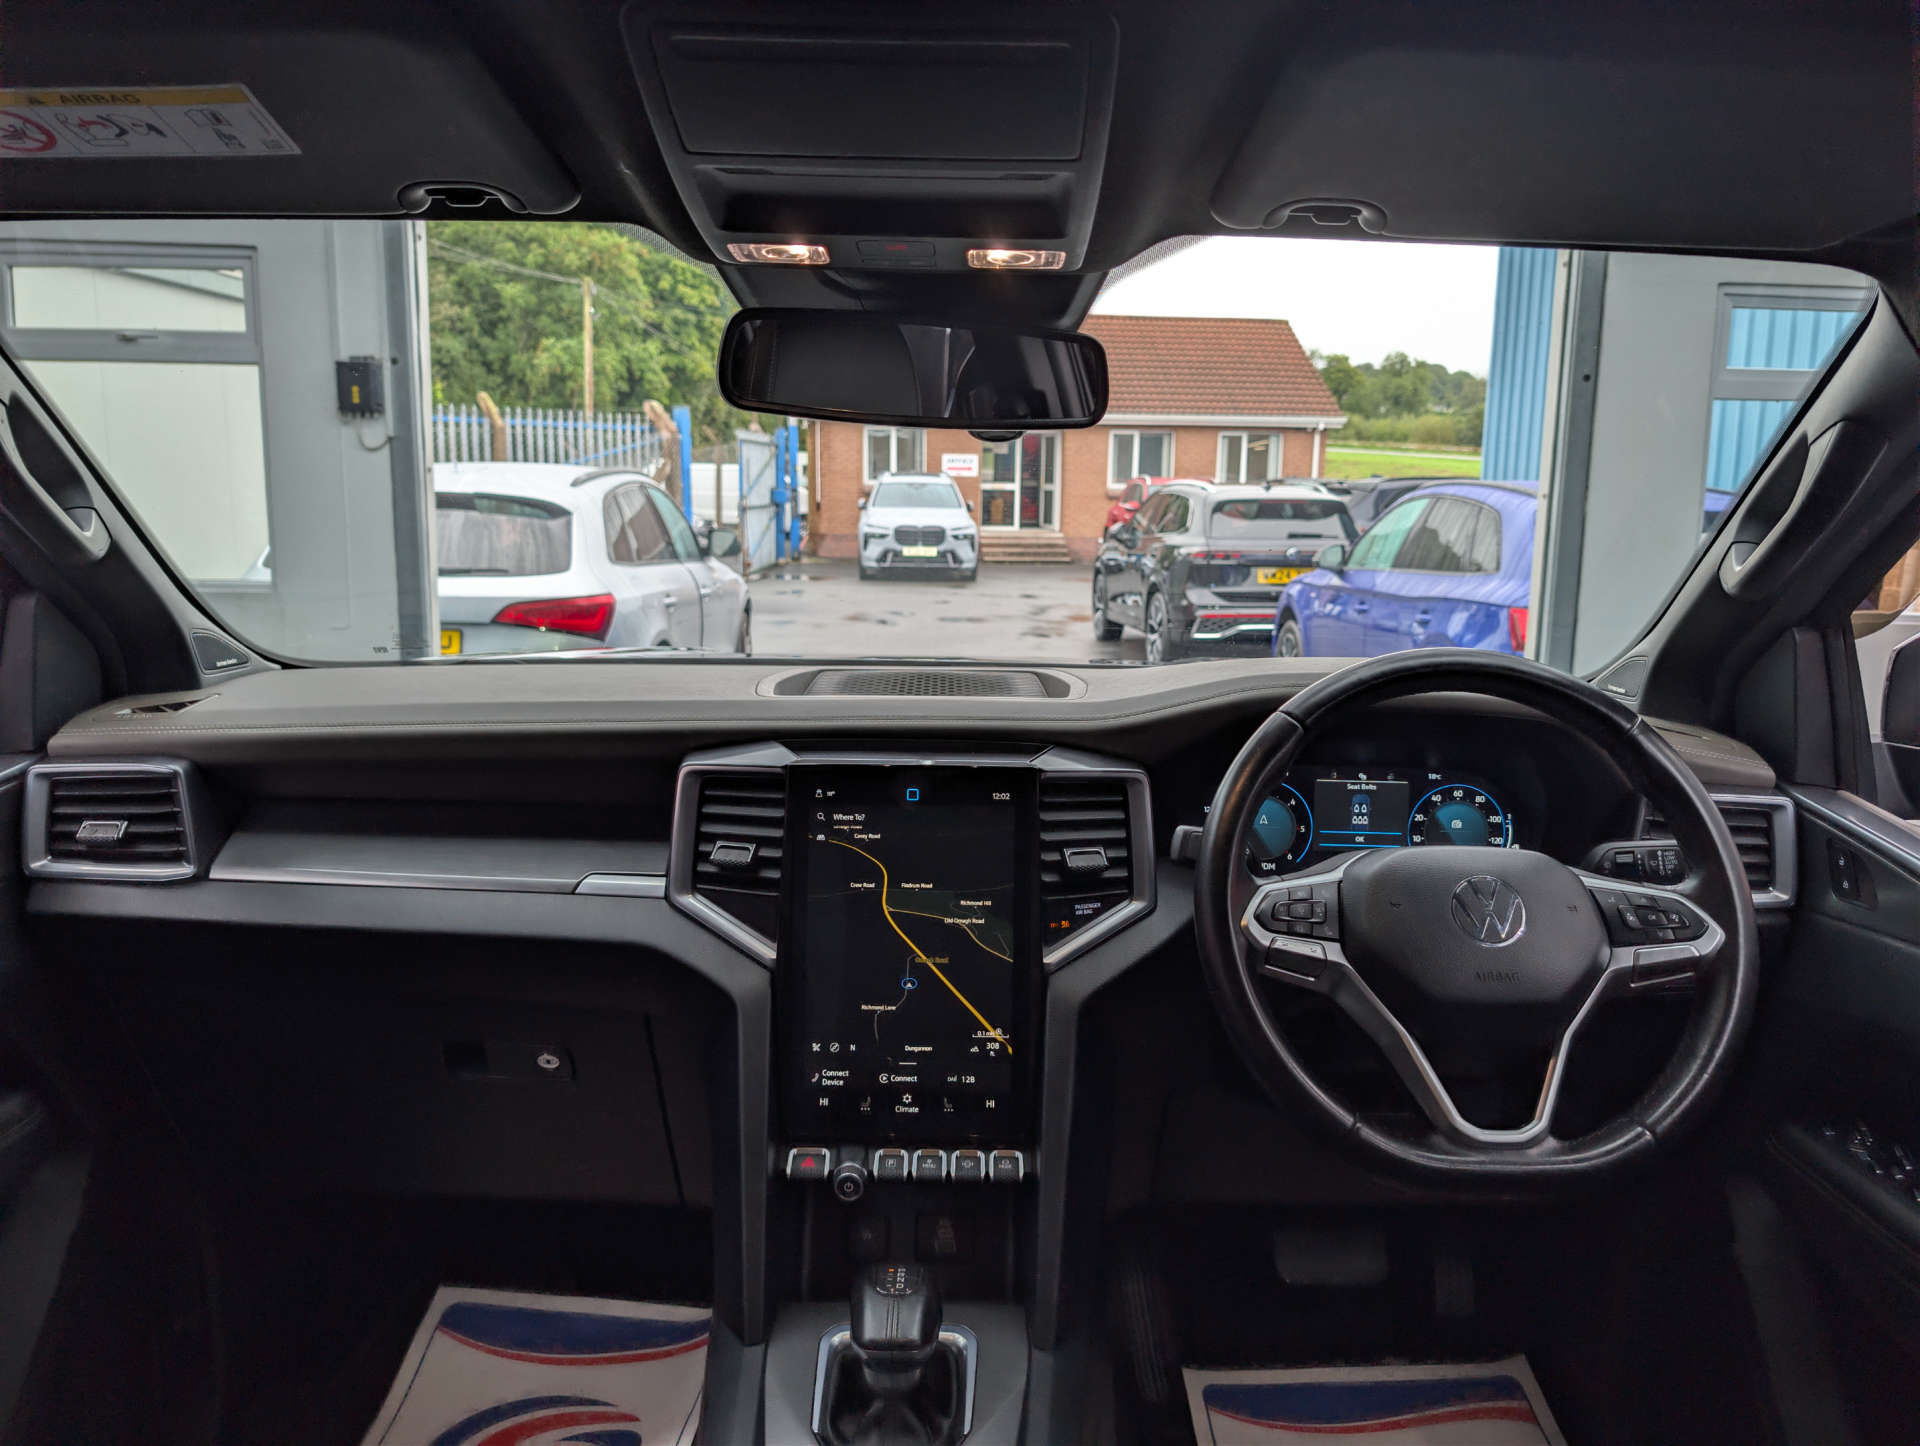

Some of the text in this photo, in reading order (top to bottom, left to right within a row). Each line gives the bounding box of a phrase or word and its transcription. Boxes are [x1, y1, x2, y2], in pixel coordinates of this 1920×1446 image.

[59, 93, 141, 105] AIRBAG
[992, 792, 1011, 801] 12:02
[1453, 790, 1463, 798] 60
[1475, 795, 1486, 803] 80
[833, 813, 866, 821] Where To?
[1414, 813, 1424, 822] 20
[1490, 815, 1502, 823] 100
[1299, 825, 1305, 833] 5
[1412, 834, 1421, 843] 10
[1490, 837, 1503, 845] 120
[822, 1069, 849, 1078] Connect
[822, 1078, 844, 1087] Device
[890, 1074, 918, 1083] Connect
[819, 1098, 829, 1107] HI
[986, 1100, 995, 1109] HI
[895, 1105, 919, 1113] Climate
